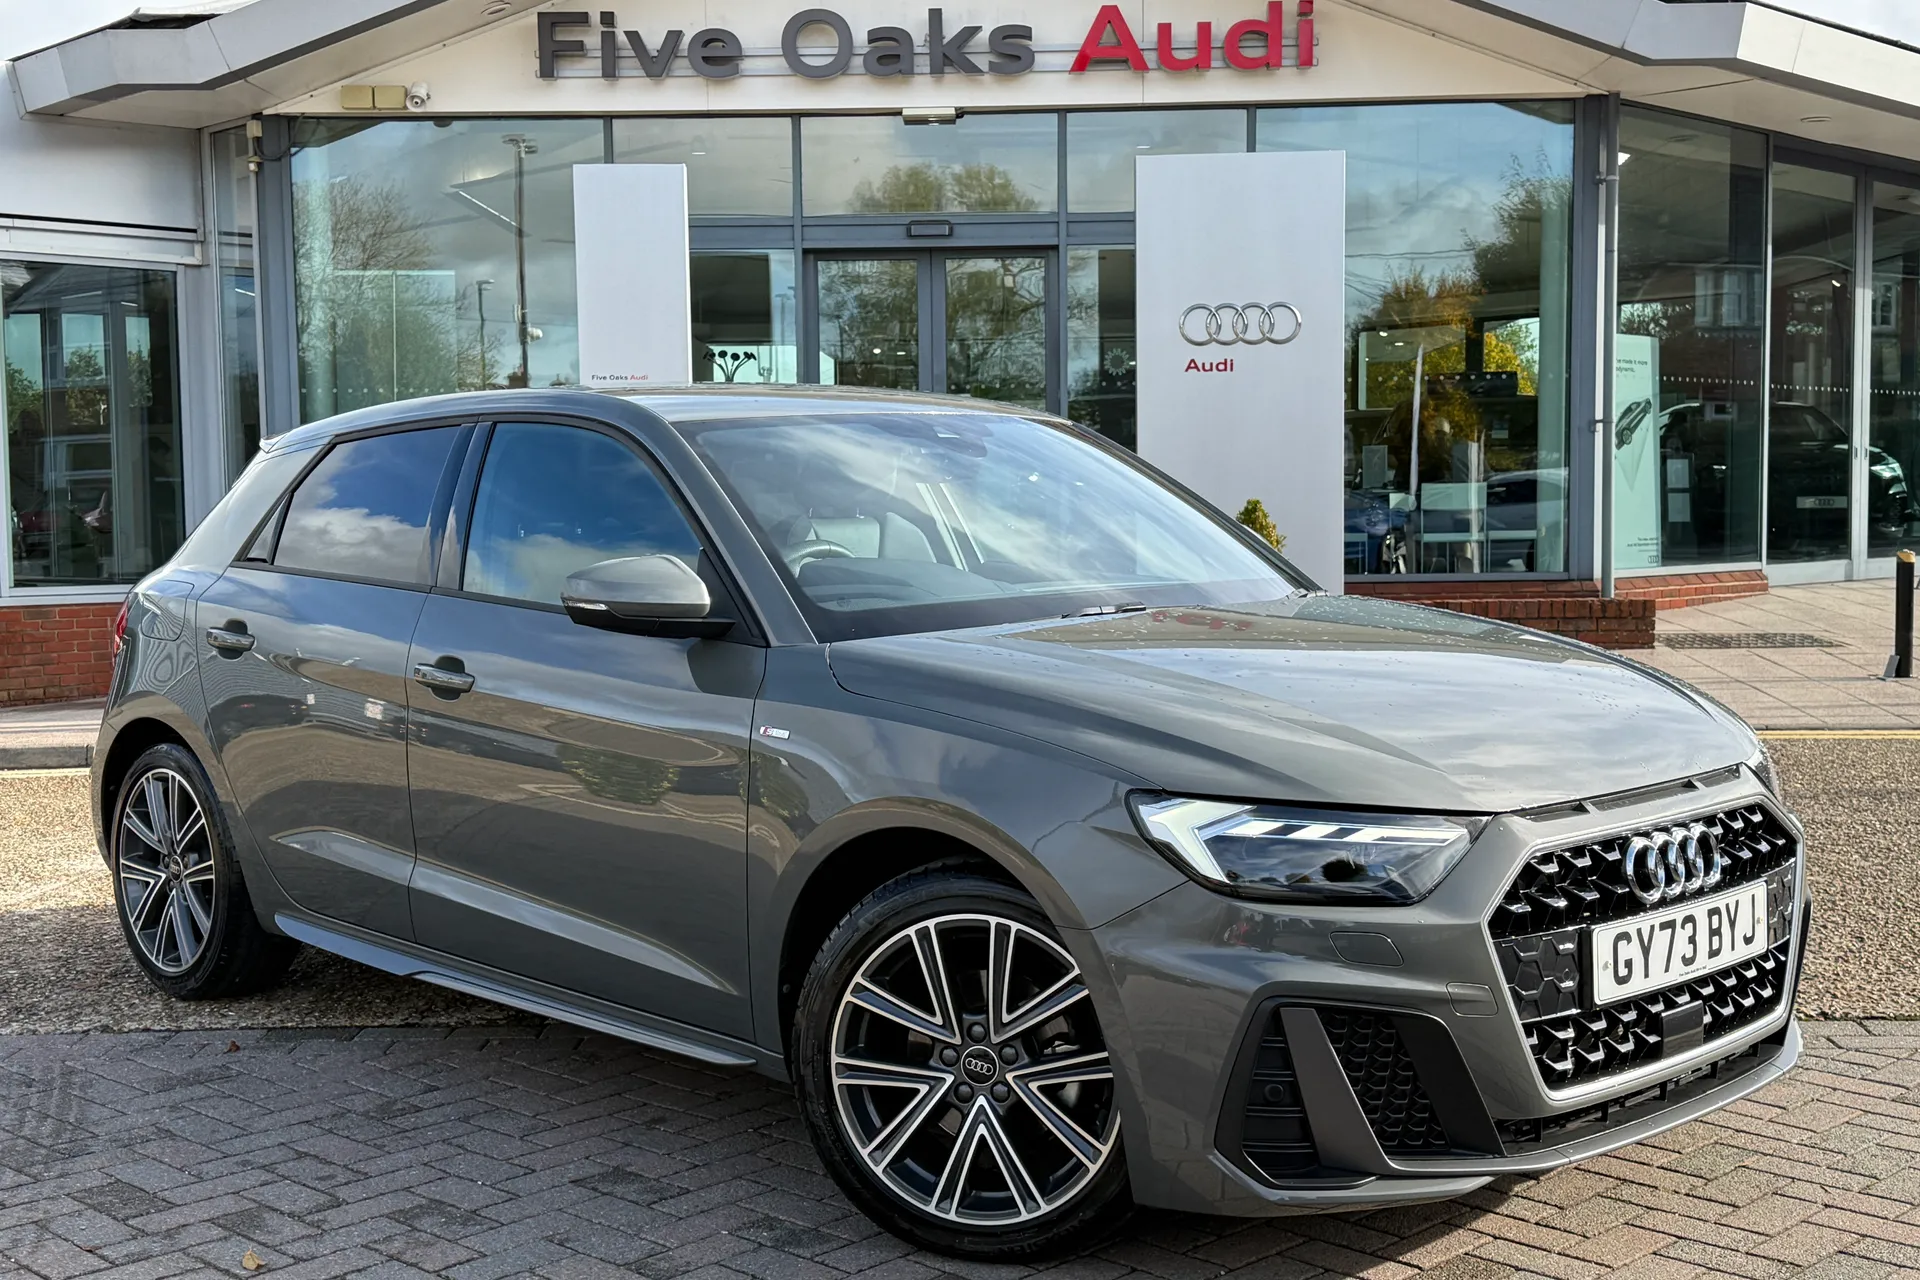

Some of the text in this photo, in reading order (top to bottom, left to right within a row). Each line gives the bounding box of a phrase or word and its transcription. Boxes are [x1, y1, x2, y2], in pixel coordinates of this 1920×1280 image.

[537, 0, 1315, 81] Five Oaks Audi
[1184, 358, 1234, 373] Audi
[1612, 893, 1756, 986] GY73 BYJ
